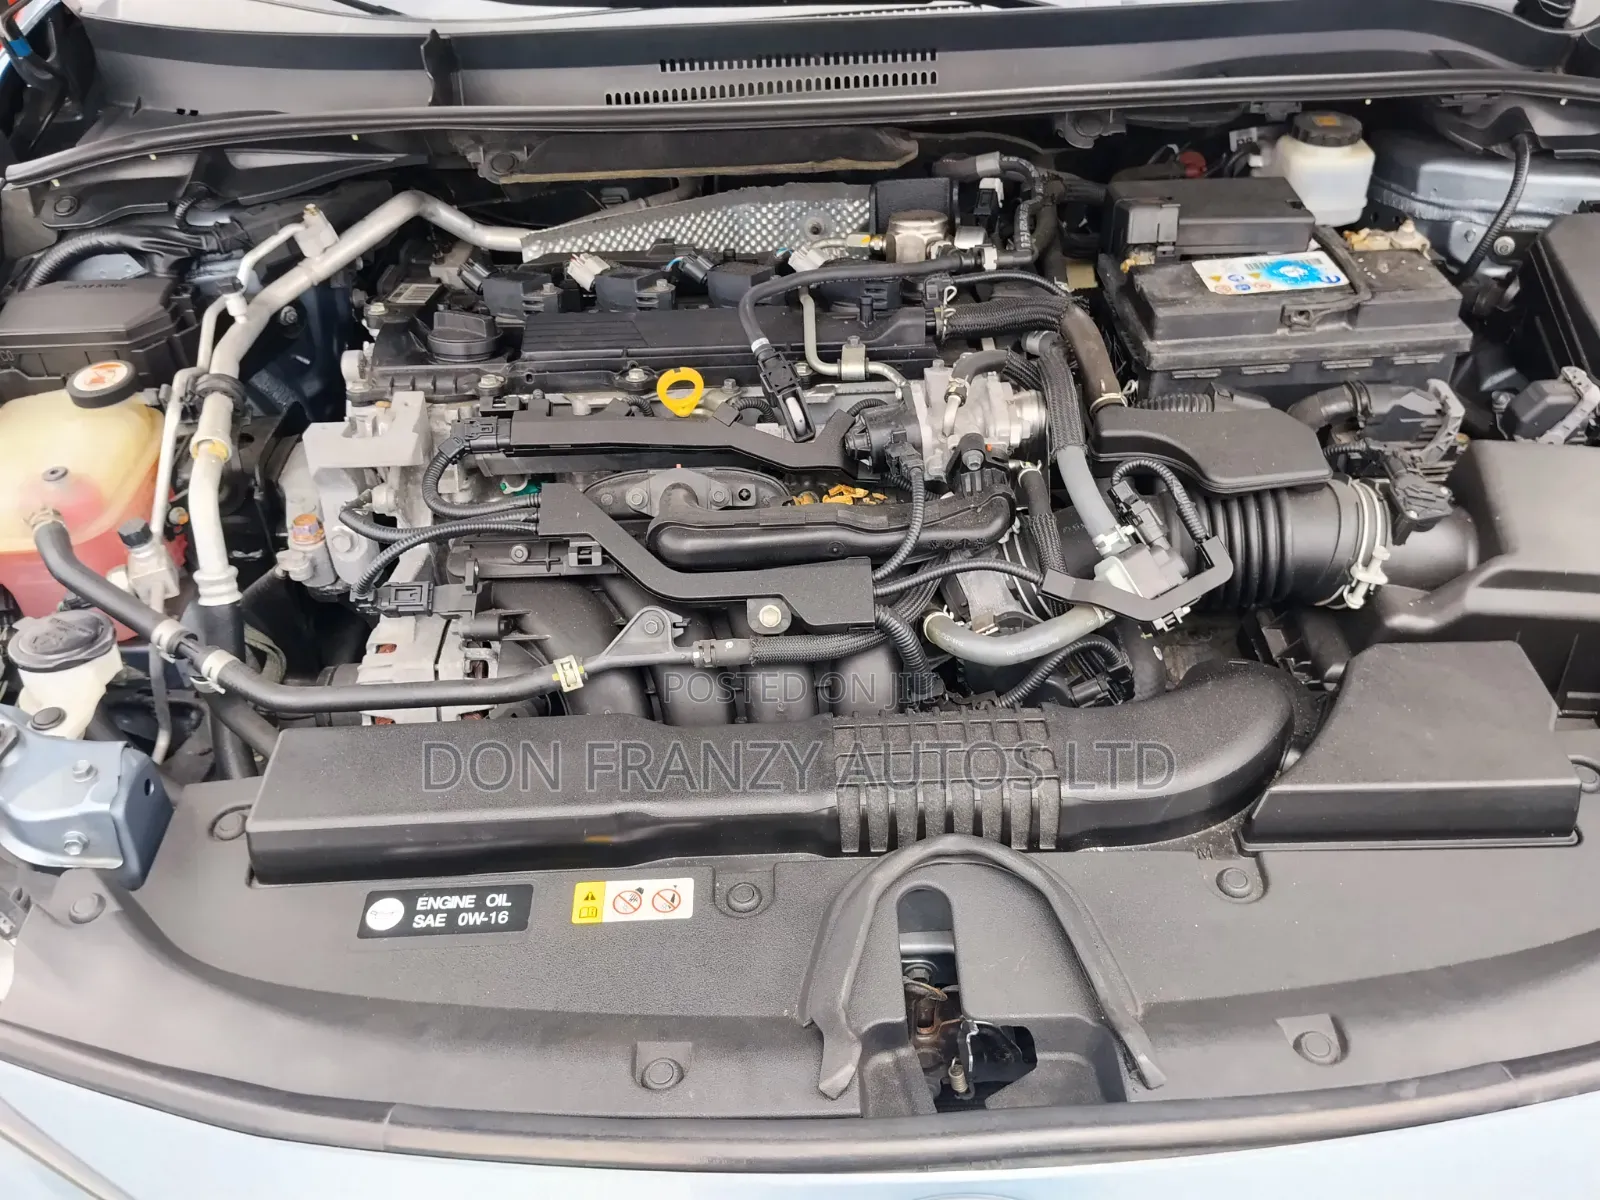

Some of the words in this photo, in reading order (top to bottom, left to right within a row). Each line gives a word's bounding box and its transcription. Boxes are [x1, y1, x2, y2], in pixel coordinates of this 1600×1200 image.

[416, 895, 477, 911] ENGINE
[485, 893, 512, 907] OIL
[412, 913, 448, 929] SAE
[457, 910, 509, 927] 0W-16
